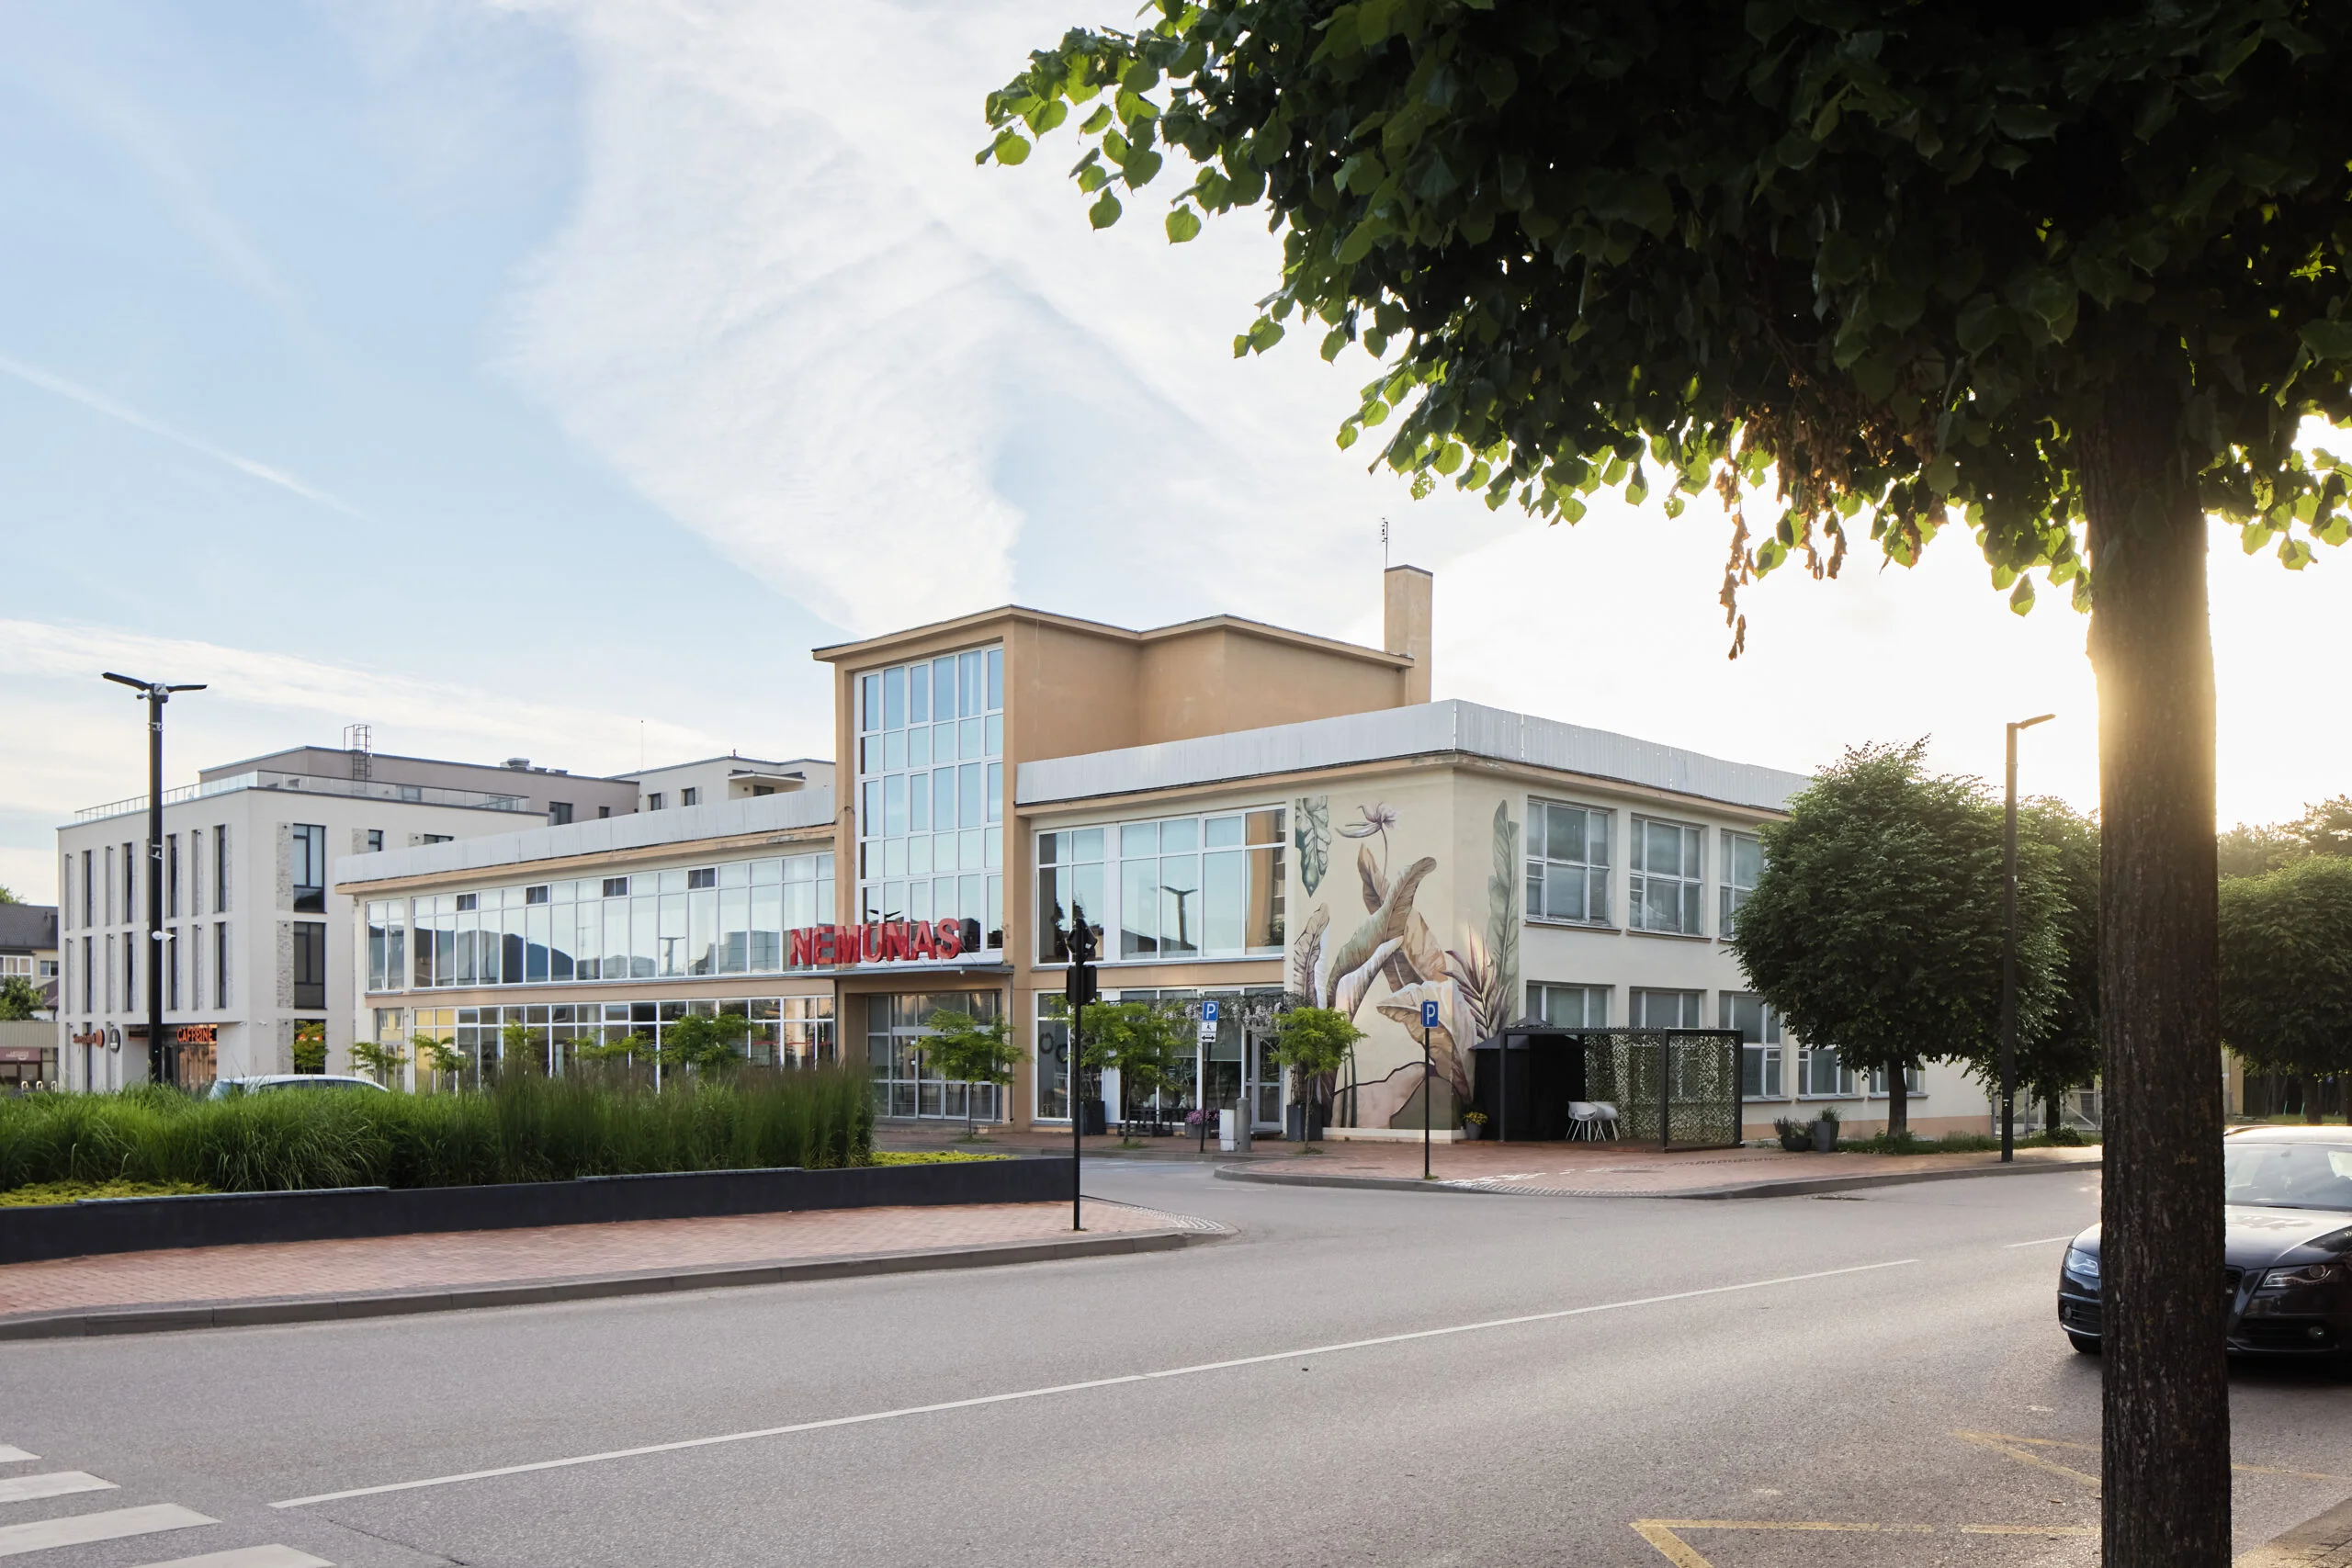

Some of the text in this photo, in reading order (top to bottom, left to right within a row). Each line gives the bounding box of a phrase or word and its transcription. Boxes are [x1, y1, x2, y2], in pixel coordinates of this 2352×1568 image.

[790, 918, 961, 965] NEMUNAS
[1205, 1003, 1216, 1020] P
[1426, 1003, 1436, 1025] P
